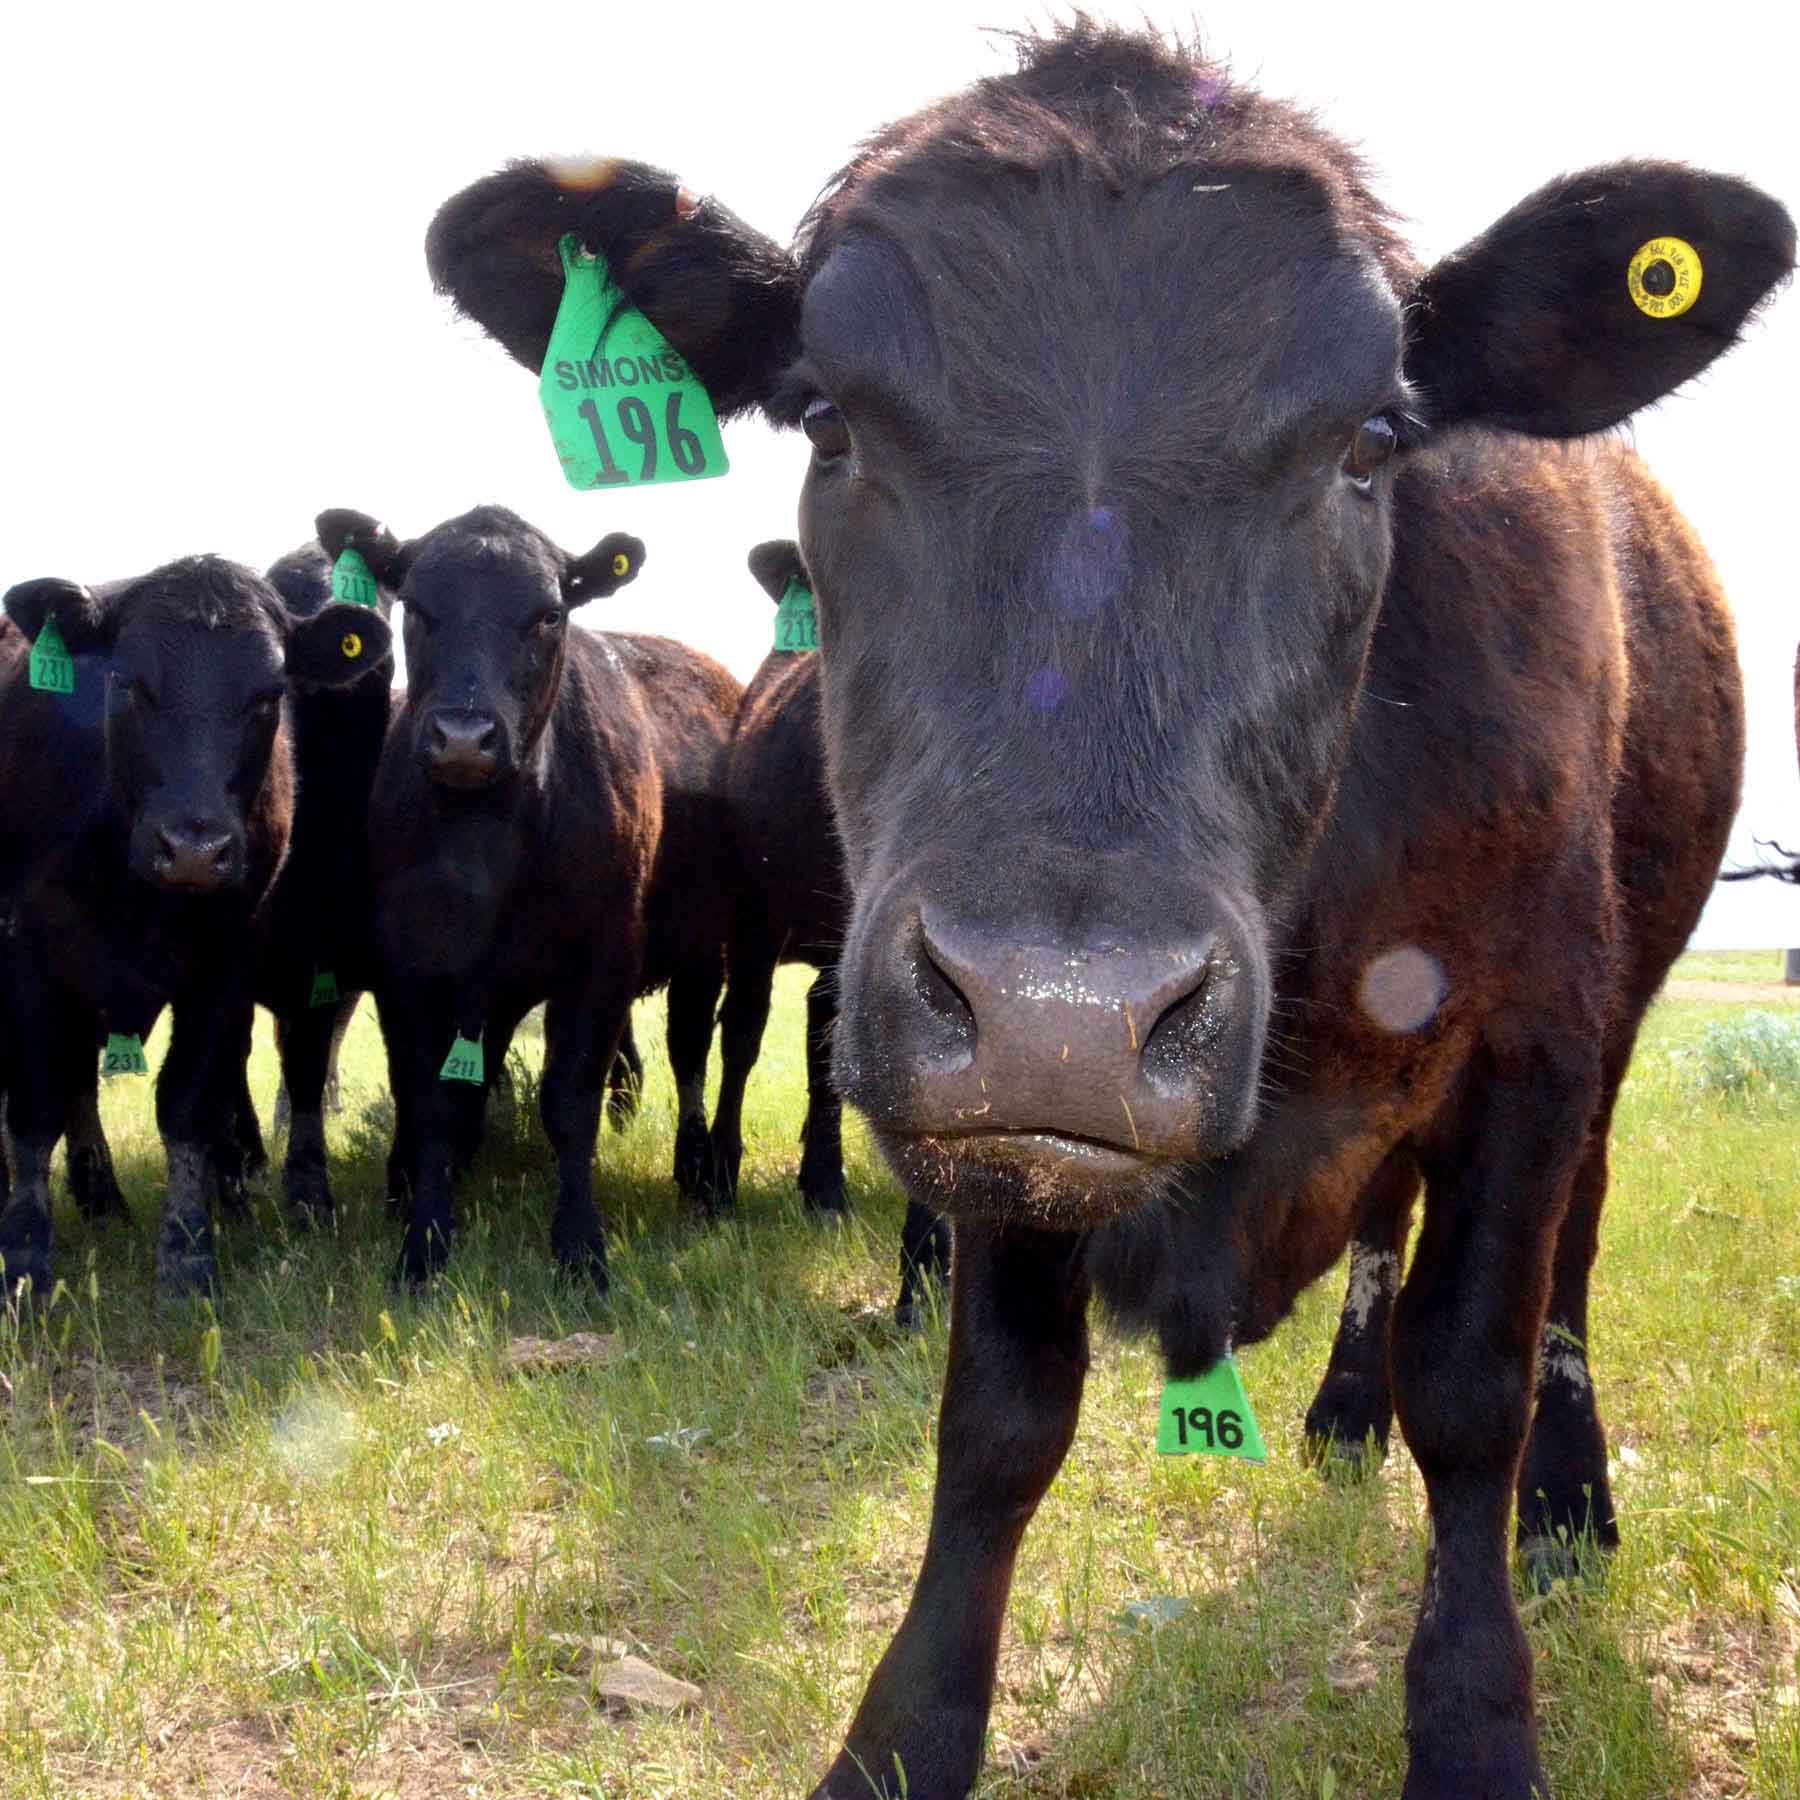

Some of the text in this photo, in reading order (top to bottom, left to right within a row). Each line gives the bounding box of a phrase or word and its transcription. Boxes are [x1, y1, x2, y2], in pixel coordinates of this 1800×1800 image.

[555, 353, 685, 391] SIMONS
[577, 391, 707, 484] 196
[106, 1053, 140, 1071] 231
[447, 1057, 475, 1077] 211
[1171, 1406, 1244, 1450] 196
